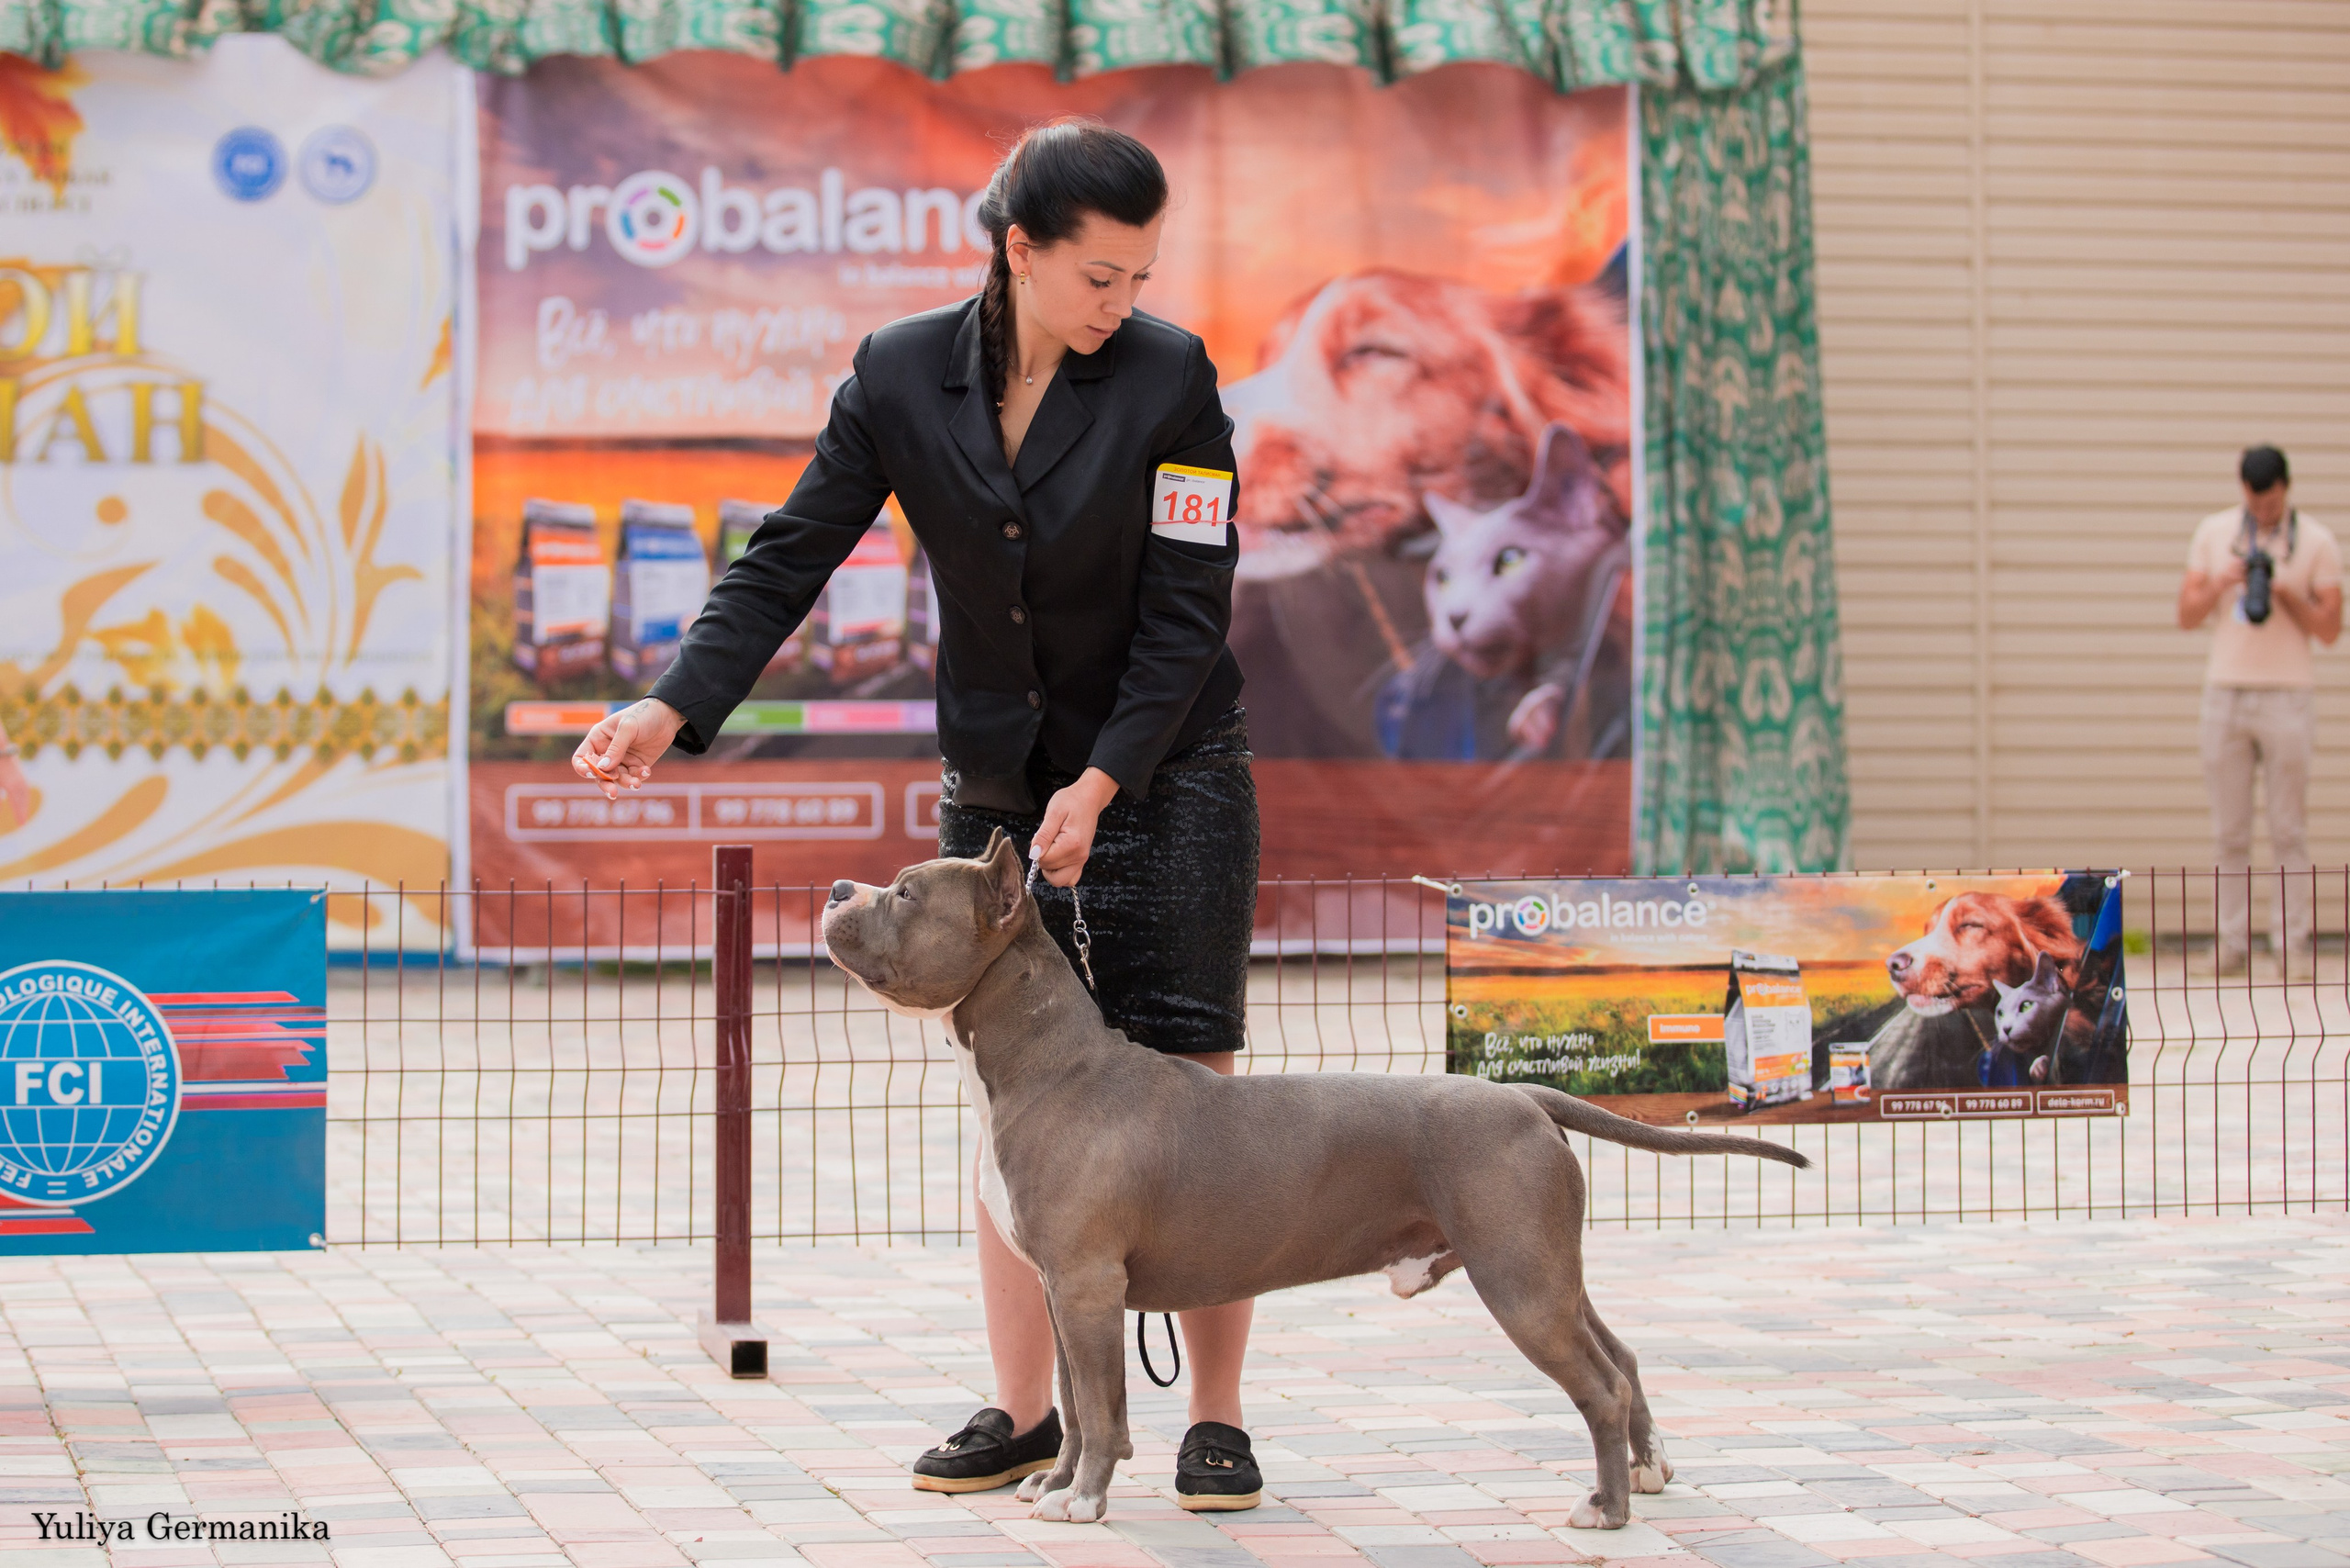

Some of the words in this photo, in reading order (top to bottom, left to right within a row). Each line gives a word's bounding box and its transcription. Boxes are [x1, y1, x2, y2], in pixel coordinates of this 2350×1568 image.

[506, 166, 994, 271] probalan
[1163, 490, 1219, 527] 181
[1469, 892, 1707, 939] probalance
[1519, 1036, 1542, 1053] что
[1547, 1033, 1595, 1055] нужно
[15, 1061, 103, 1106] FCI
[82, 1000, 168, 1188] INTERNATIONALE
